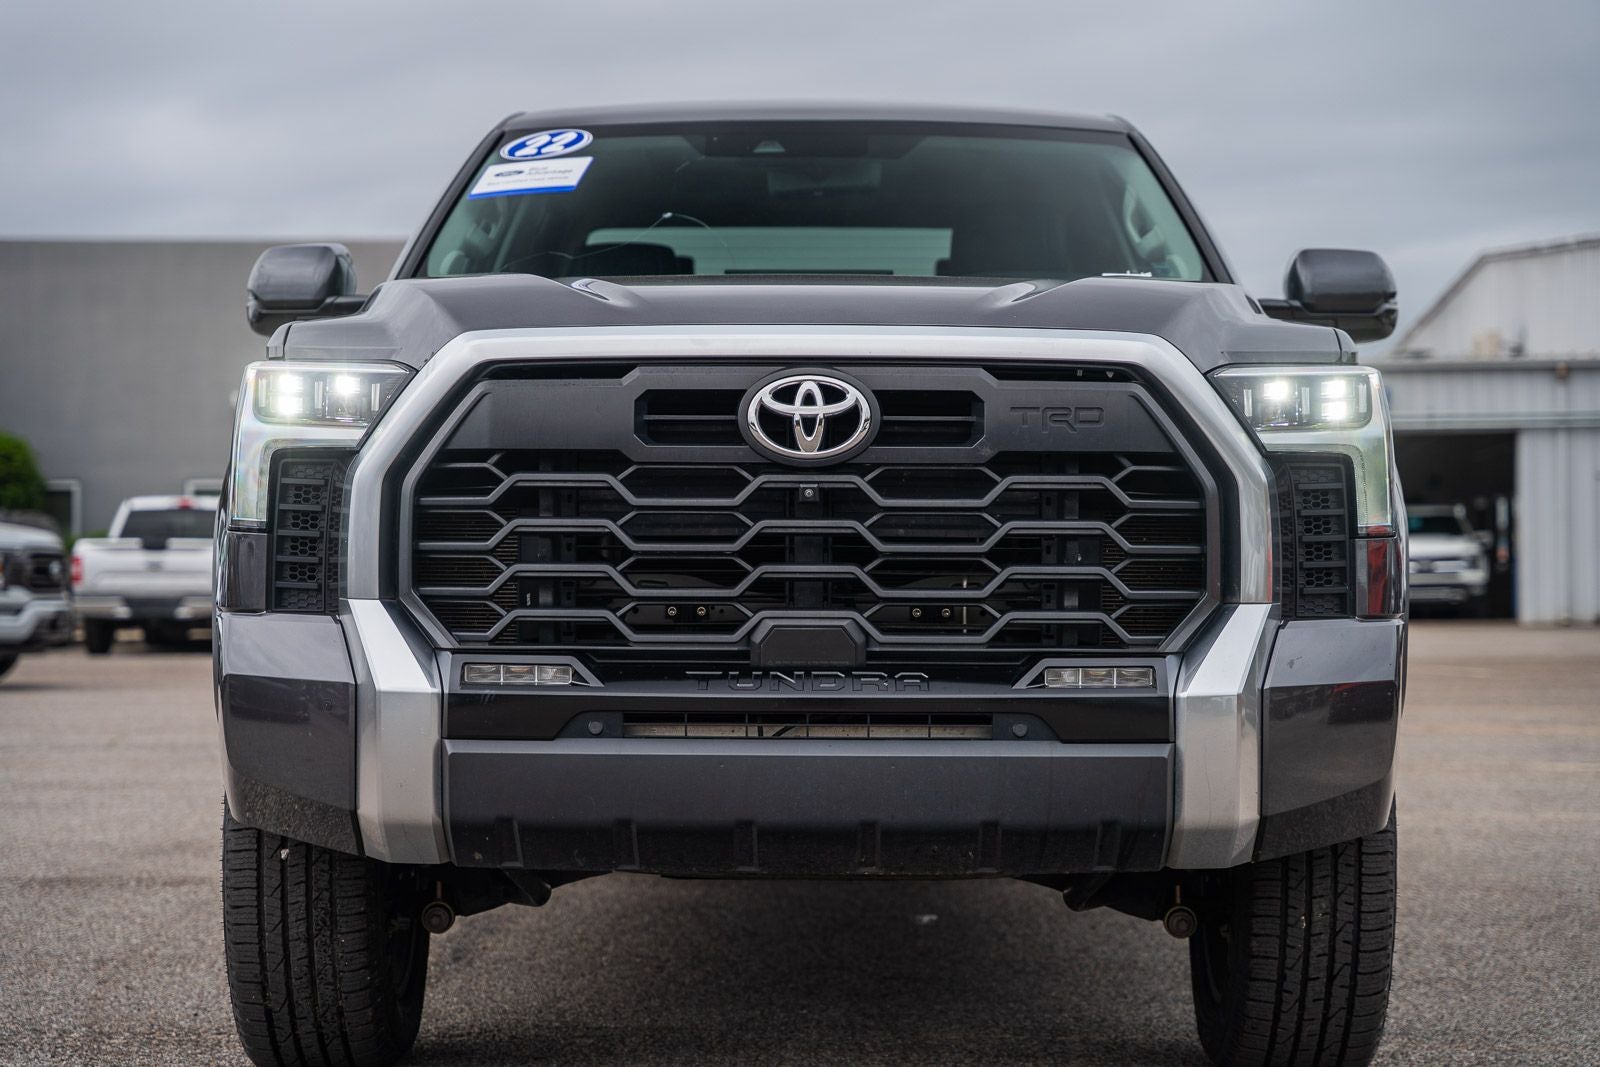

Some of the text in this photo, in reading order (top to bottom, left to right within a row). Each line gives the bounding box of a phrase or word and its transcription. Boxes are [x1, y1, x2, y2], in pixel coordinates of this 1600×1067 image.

[514, 131, 579, 157] 22
[1010, 406, 1104, 433] TRD
[685, 671, 930, 691] TUNDRA
